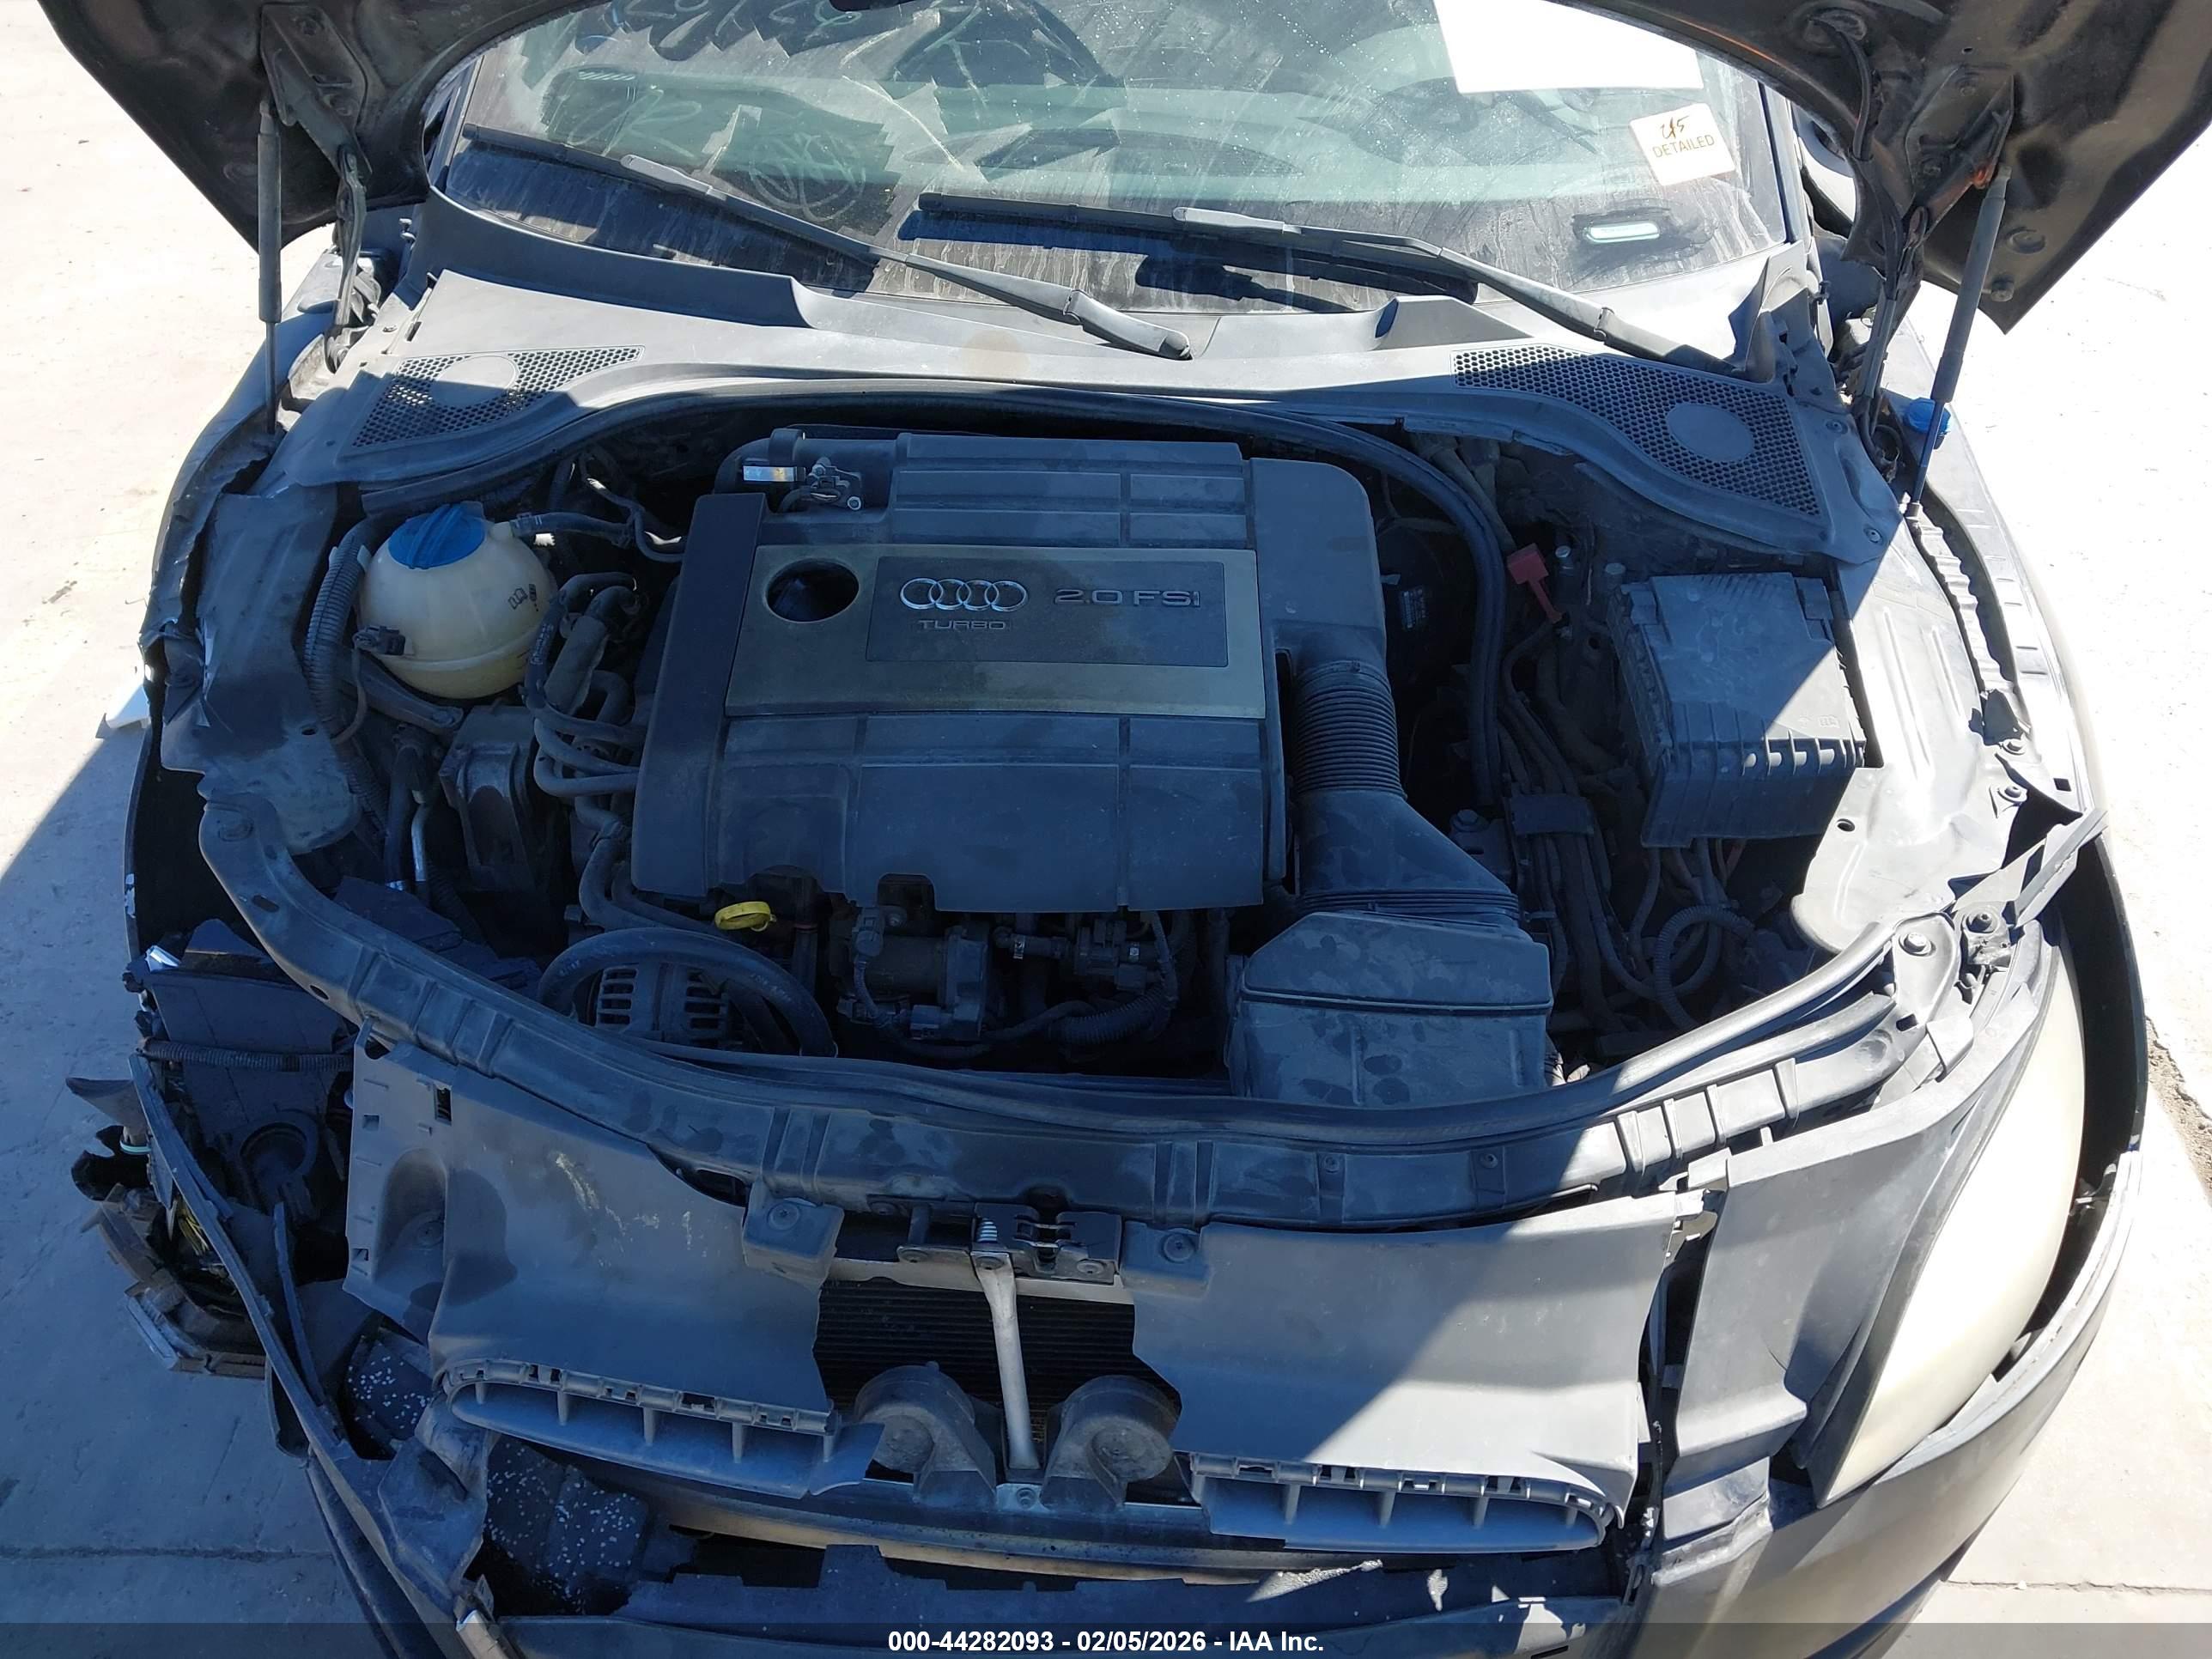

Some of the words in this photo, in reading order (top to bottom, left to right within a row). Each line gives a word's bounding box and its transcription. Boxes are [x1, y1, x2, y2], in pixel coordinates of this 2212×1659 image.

[1652, 134, 1716, 158] DETAILED
[1054, 588, 1123, 605] 2.0
[918, 620, 1006, 630] TURBO
